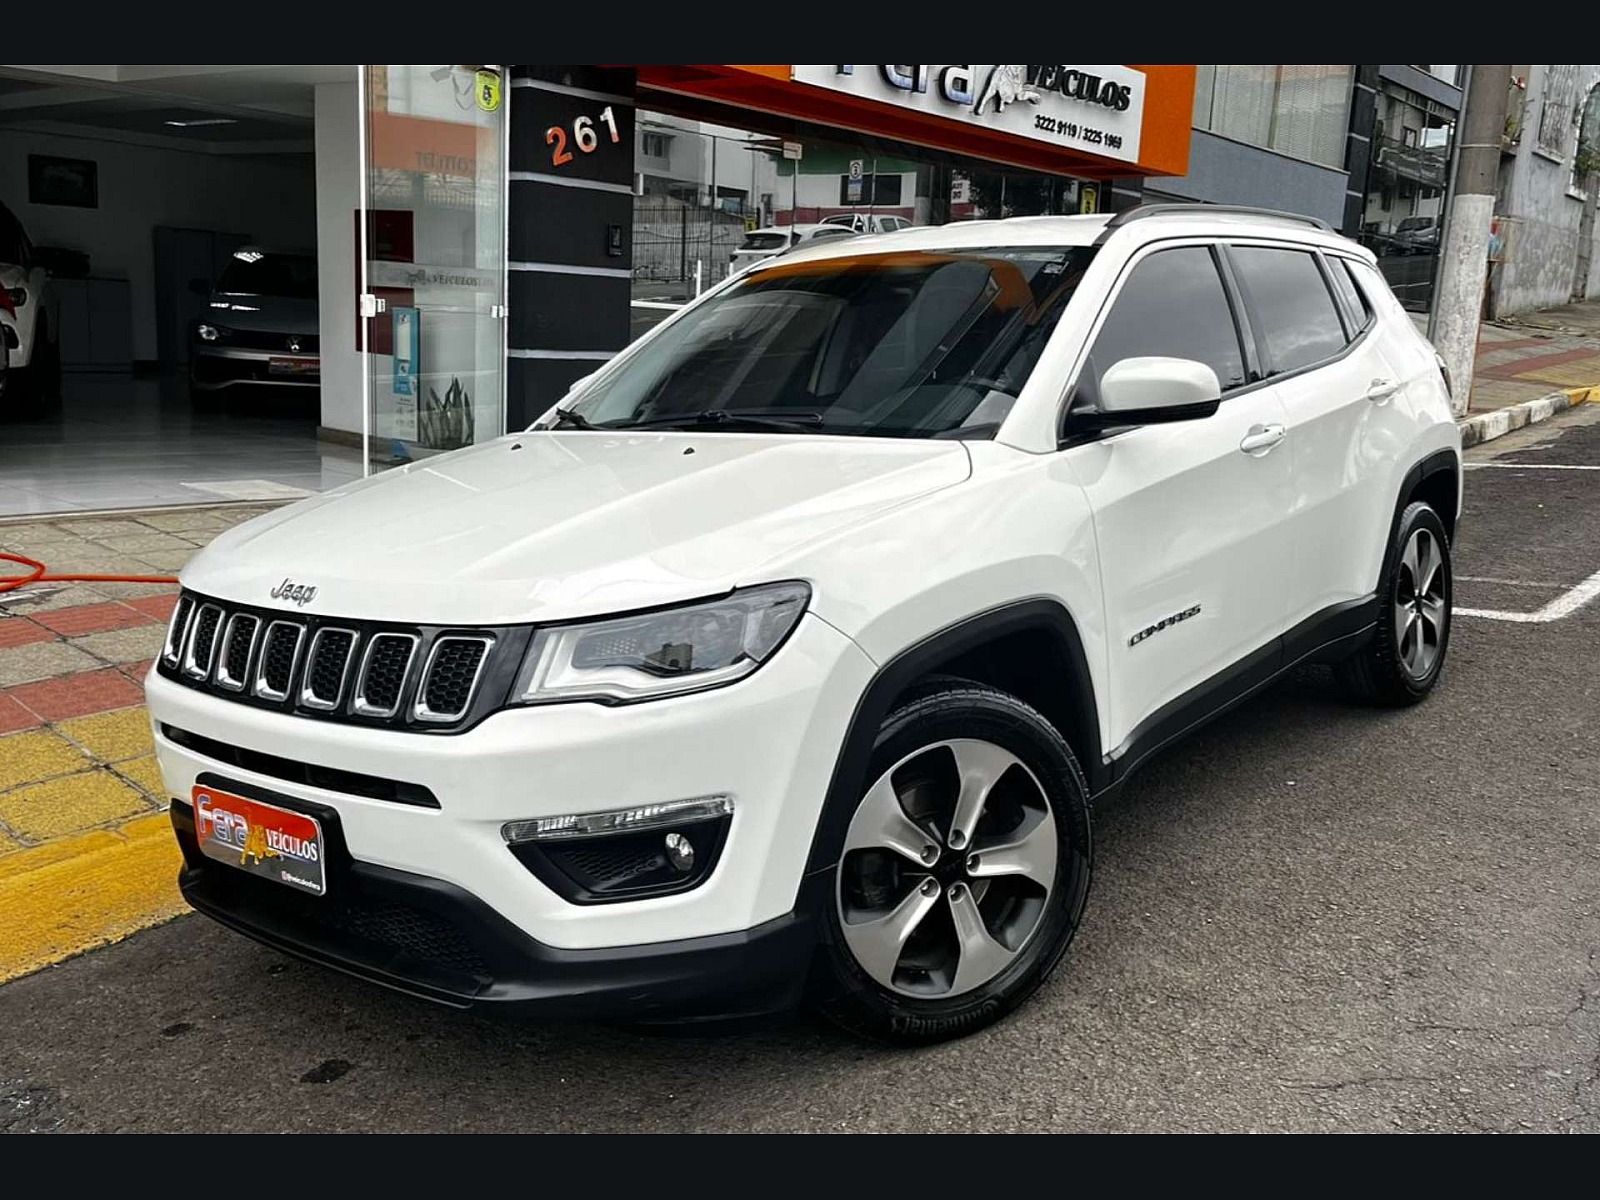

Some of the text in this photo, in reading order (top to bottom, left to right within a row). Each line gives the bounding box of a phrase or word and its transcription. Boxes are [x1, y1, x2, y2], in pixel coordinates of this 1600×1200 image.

[546, 106, 620, 166] 261
[1034, 114, 1056, 132] 3222
[1057, 120, 1077, 137] 9119
[1083, 127, 1102, 144] 3225
[270, 577, 318, 607] Jeep
[1128, 604, 1201, 647] COMPASS
